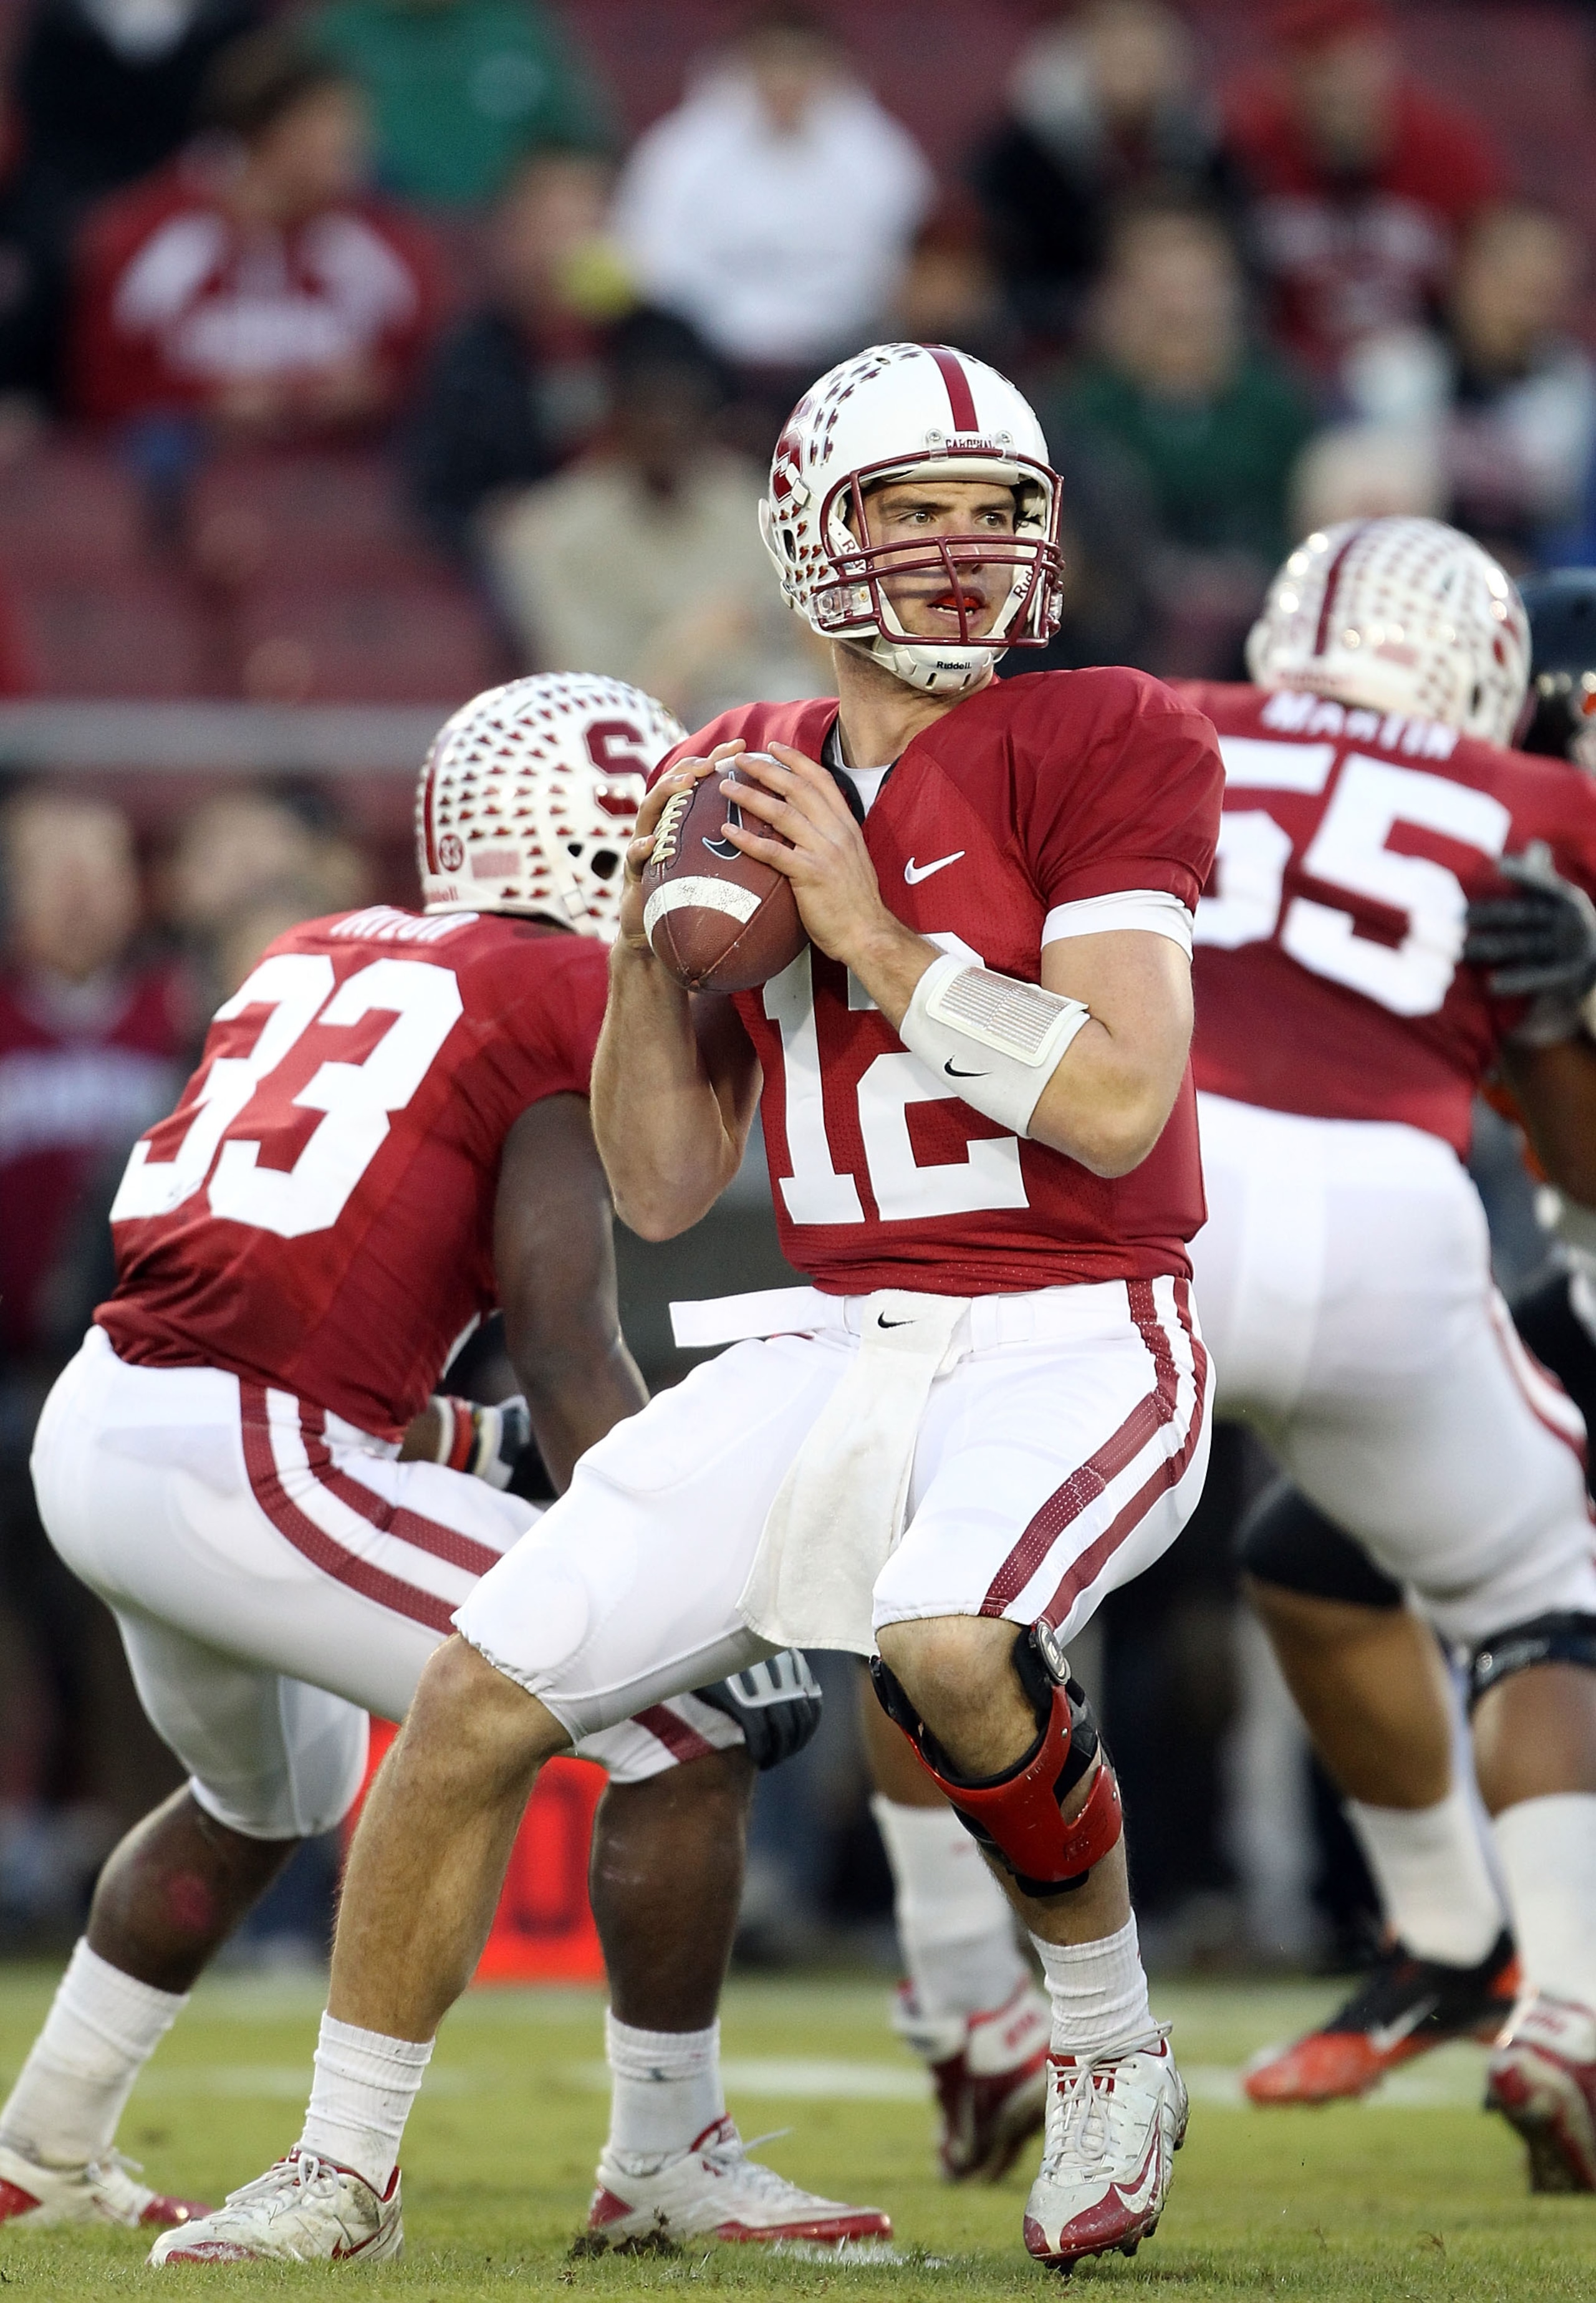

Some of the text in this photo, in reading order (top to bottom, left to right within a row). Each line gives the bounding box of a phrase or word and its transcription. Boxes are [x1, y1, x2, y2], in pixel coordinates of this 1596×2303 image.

[936, 660, 972, 670] Riddell
[584, 719, 653, 818] S
[108, 952, 464, 1240] 33
[762, 931, 1031, 1225] 12
